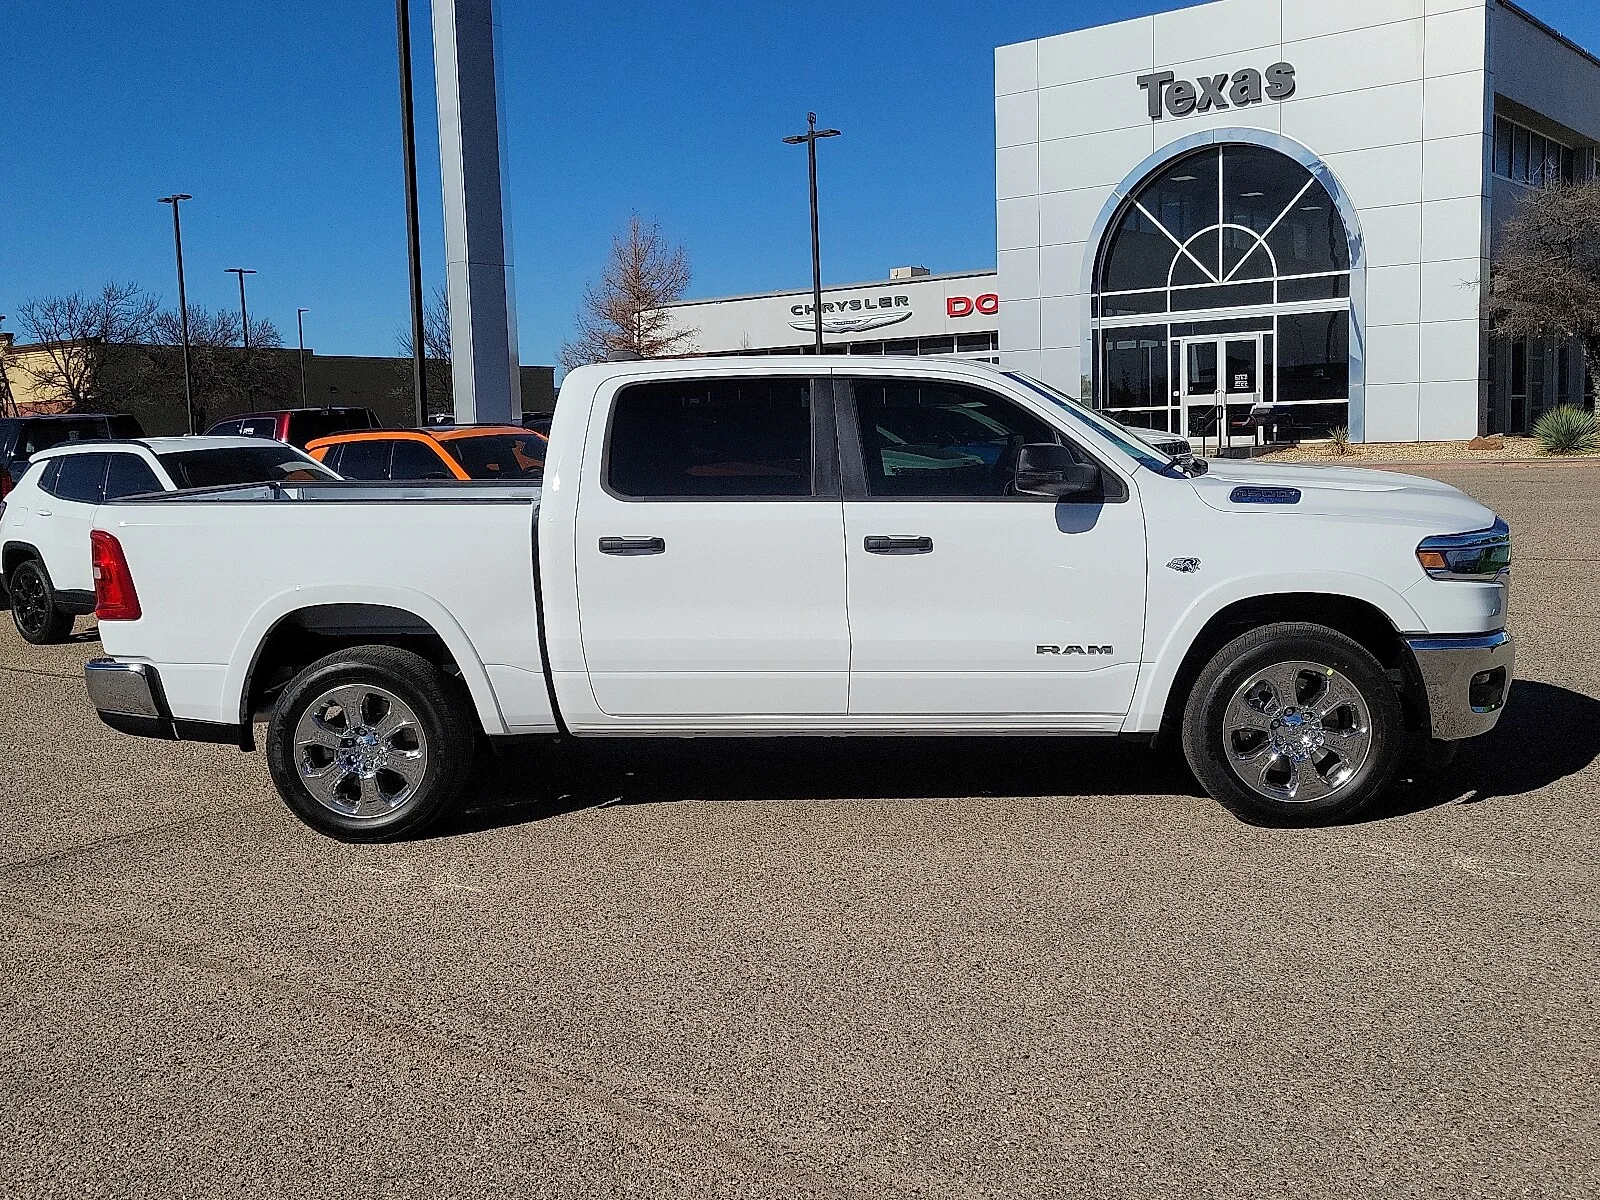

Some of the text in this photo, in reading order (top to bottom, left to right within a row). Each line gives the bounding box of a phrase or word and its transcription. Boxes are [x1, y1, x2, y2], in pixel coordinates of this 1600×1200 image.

[1136, 62, 1296, 120] Texas
[790, 295, 910, 316] CHRYSLER
[1036, 645, 1113, 655] RAM
